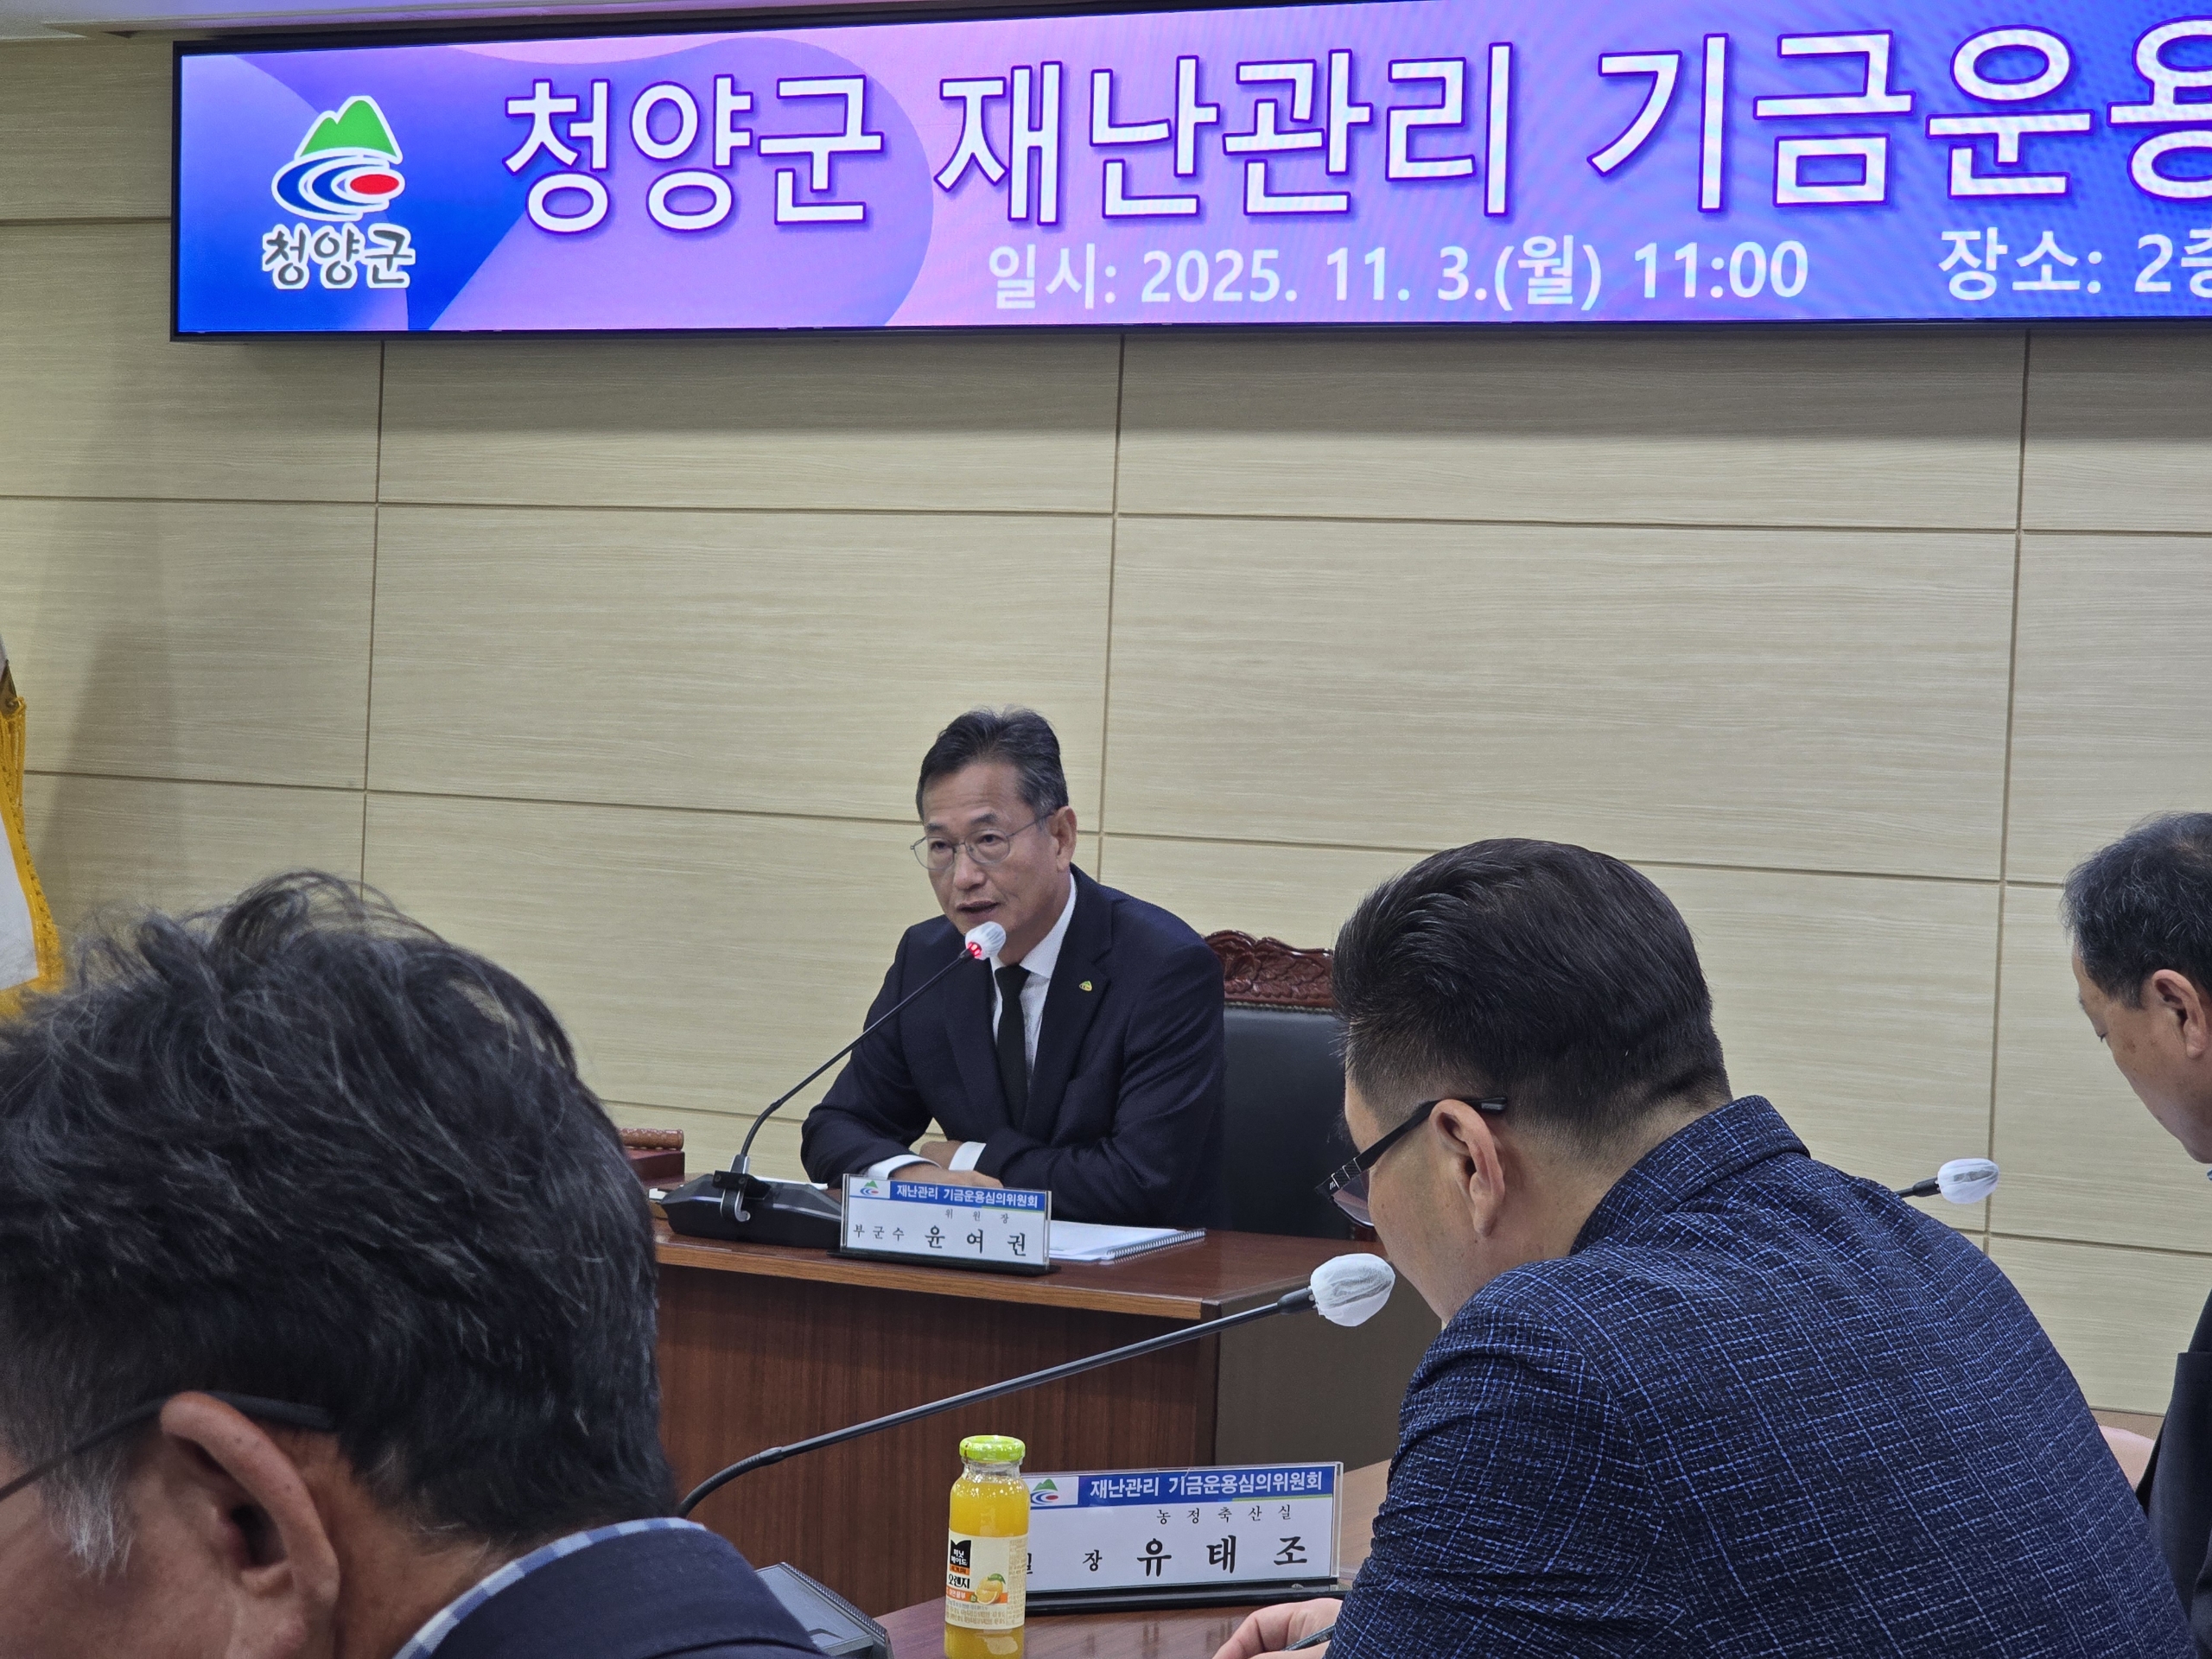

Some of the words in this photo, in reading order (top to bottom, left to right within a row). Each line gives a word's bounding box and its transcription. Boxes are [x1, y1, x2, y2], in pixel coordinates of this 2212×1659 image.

[504, 74, 883, 233] 청양군
[934, 42, 1512, 225] 재난관리
[1587, 16, 2212, 212] 기금운용
[262, 222, 416, 289] 청양군
[988, 243, 1117, 310] 일시:
[1141, 249, 1298, 303] 2025.
[1325, 247, 1410, 302] 11.
[1438, 233, 1603, 312] 3.(월)
[1633, 239, 1808, 300] 11:00
[1938, 227, 2103, 302] 장소:
[896, 1184, 938, 1200] 재난관리
[943, 1189, 1038, 1208] 기금운용심의위원회
[1090, 1477, 1160, 1499] 재난관리
[1168, 1471, 1323, 1497] 기금운용심의위원회
[948, 1573, 970, 1589] 오렌지
